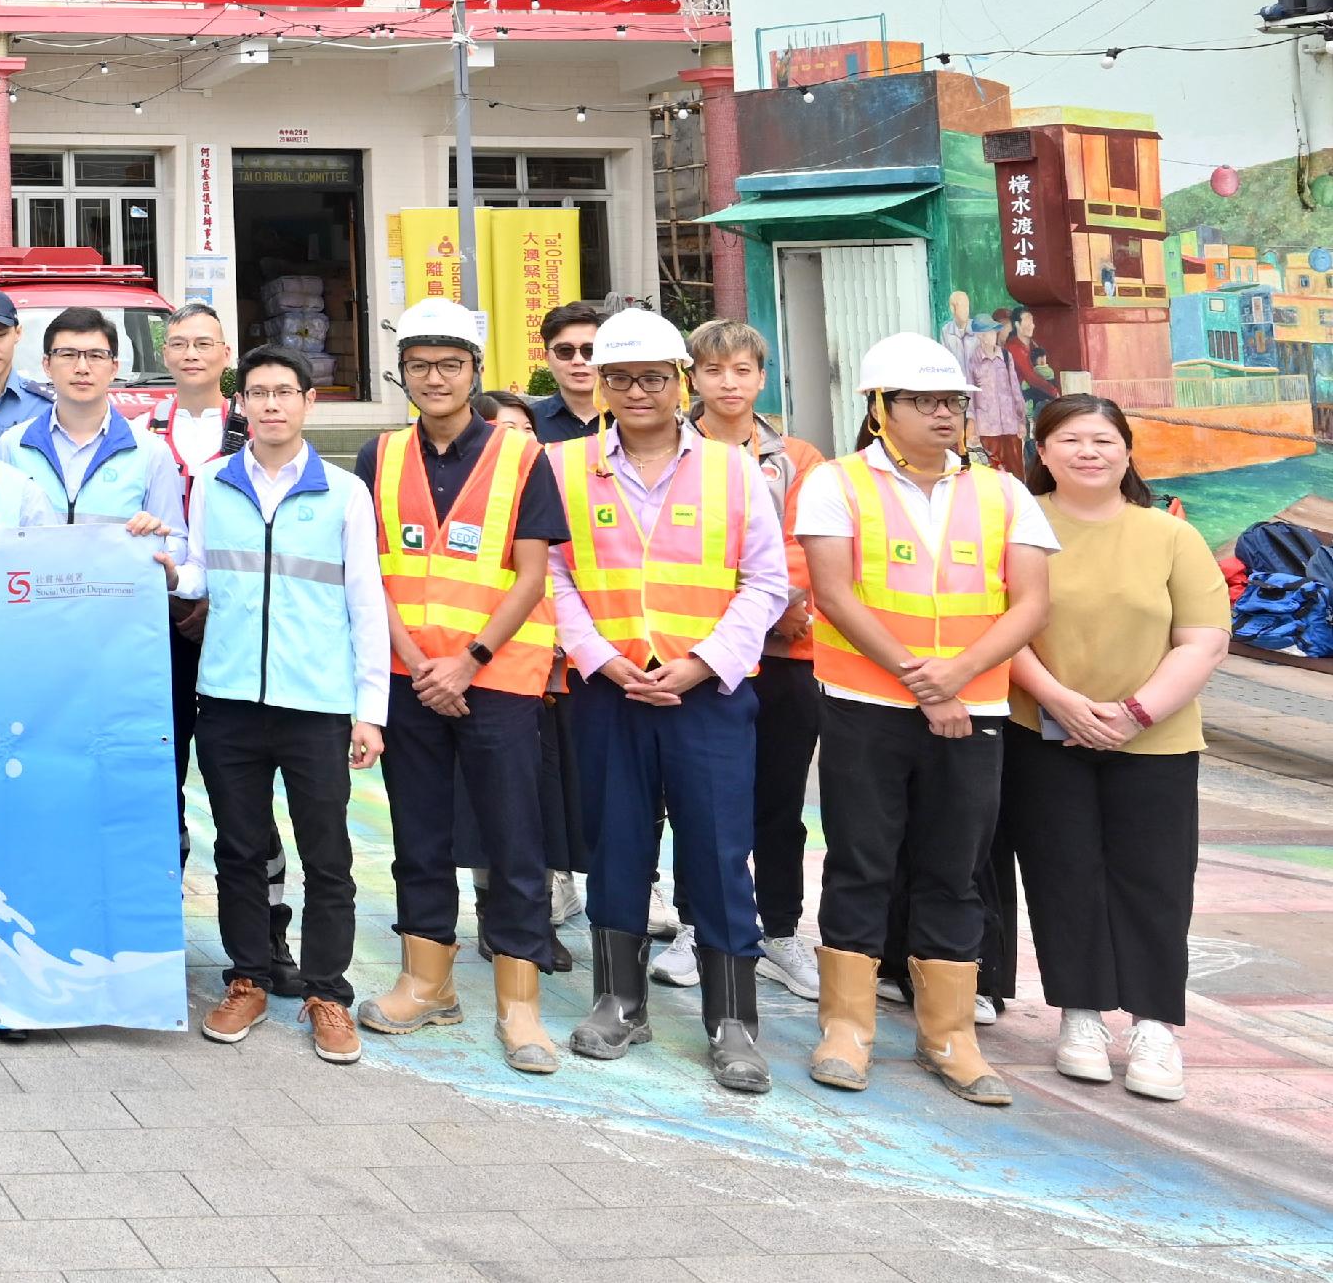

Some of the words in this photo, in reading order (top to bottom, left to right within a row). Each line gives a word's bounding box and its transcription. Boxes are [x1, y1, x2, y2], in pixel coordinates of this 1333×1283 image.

[238, 171, 253, 183] TAI
[264, 171, 294, 183] RURAL
[298, 170, 349, 183] COMMITTEE
[1008, 174, 1037, 276] 橫水渡小廚
[545, 232, 563, 247] Tai
[449, 531, 479, 545] CEDD
